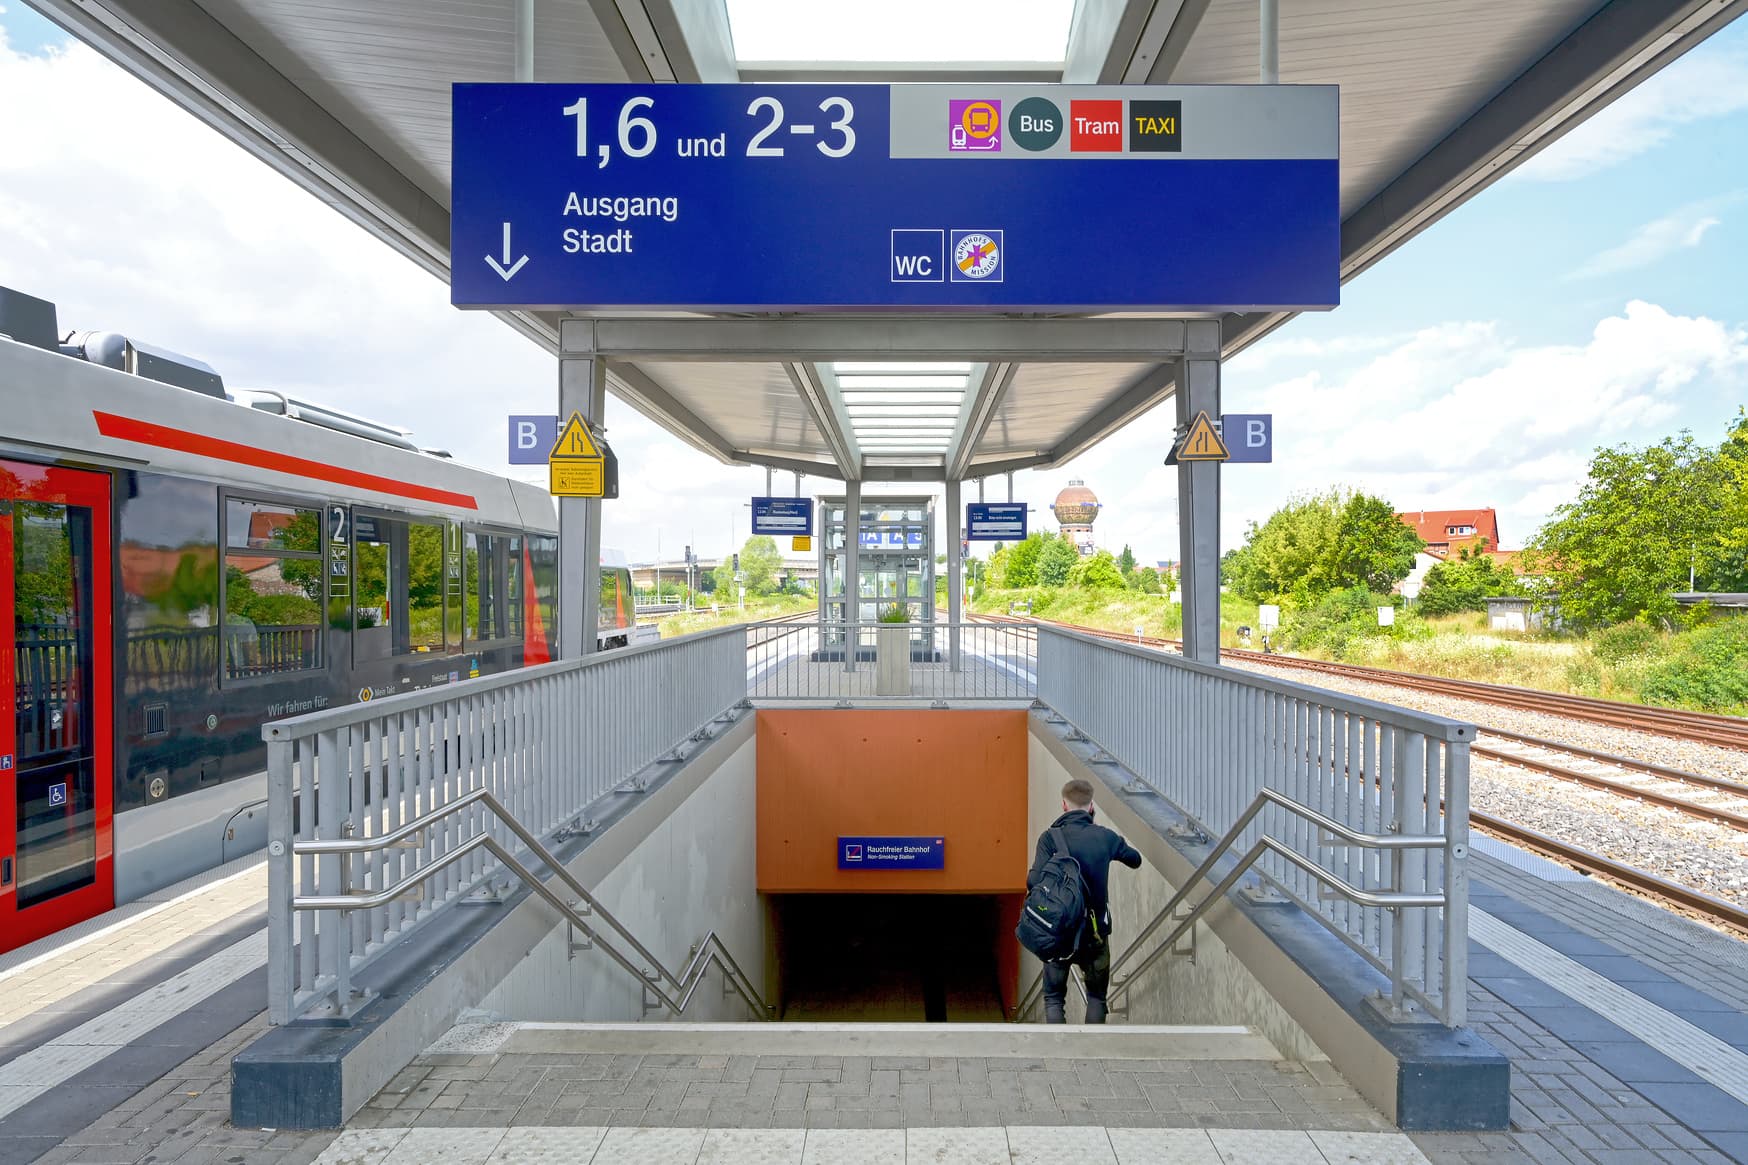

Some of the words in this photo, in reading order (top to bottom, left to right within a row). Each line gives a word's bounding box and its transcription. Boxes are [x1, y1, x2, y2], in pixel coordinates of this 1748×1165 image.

[562, 96, 657, 168] 1,6
[678, 133, 726, 157] und
[746, 97, 856, 158] 2-3
[1020, 115, 1054, 133] Bus
[1075, 117, 1119, 135] Tram
[1135, 117, 1175, 135] TAXI
[563, 192, 678, 222] Ausgang
[562, 228, 633, 254] Stadt
[958, 236, 987, 260] BAHNHOFS
[895, 255, 931, 276] WC
[971, 255, 997, 276] MISSION
[517, 421, 538, 449] B
[1246, 420, 1267, 448] B
[333, 507, 345, 543] 2
[450, 523, 457, 552] 1
[267, 704, 284, 717] Wir
[285, 698, 313, 714] fahren
[314, 695, 329, 708] für:
